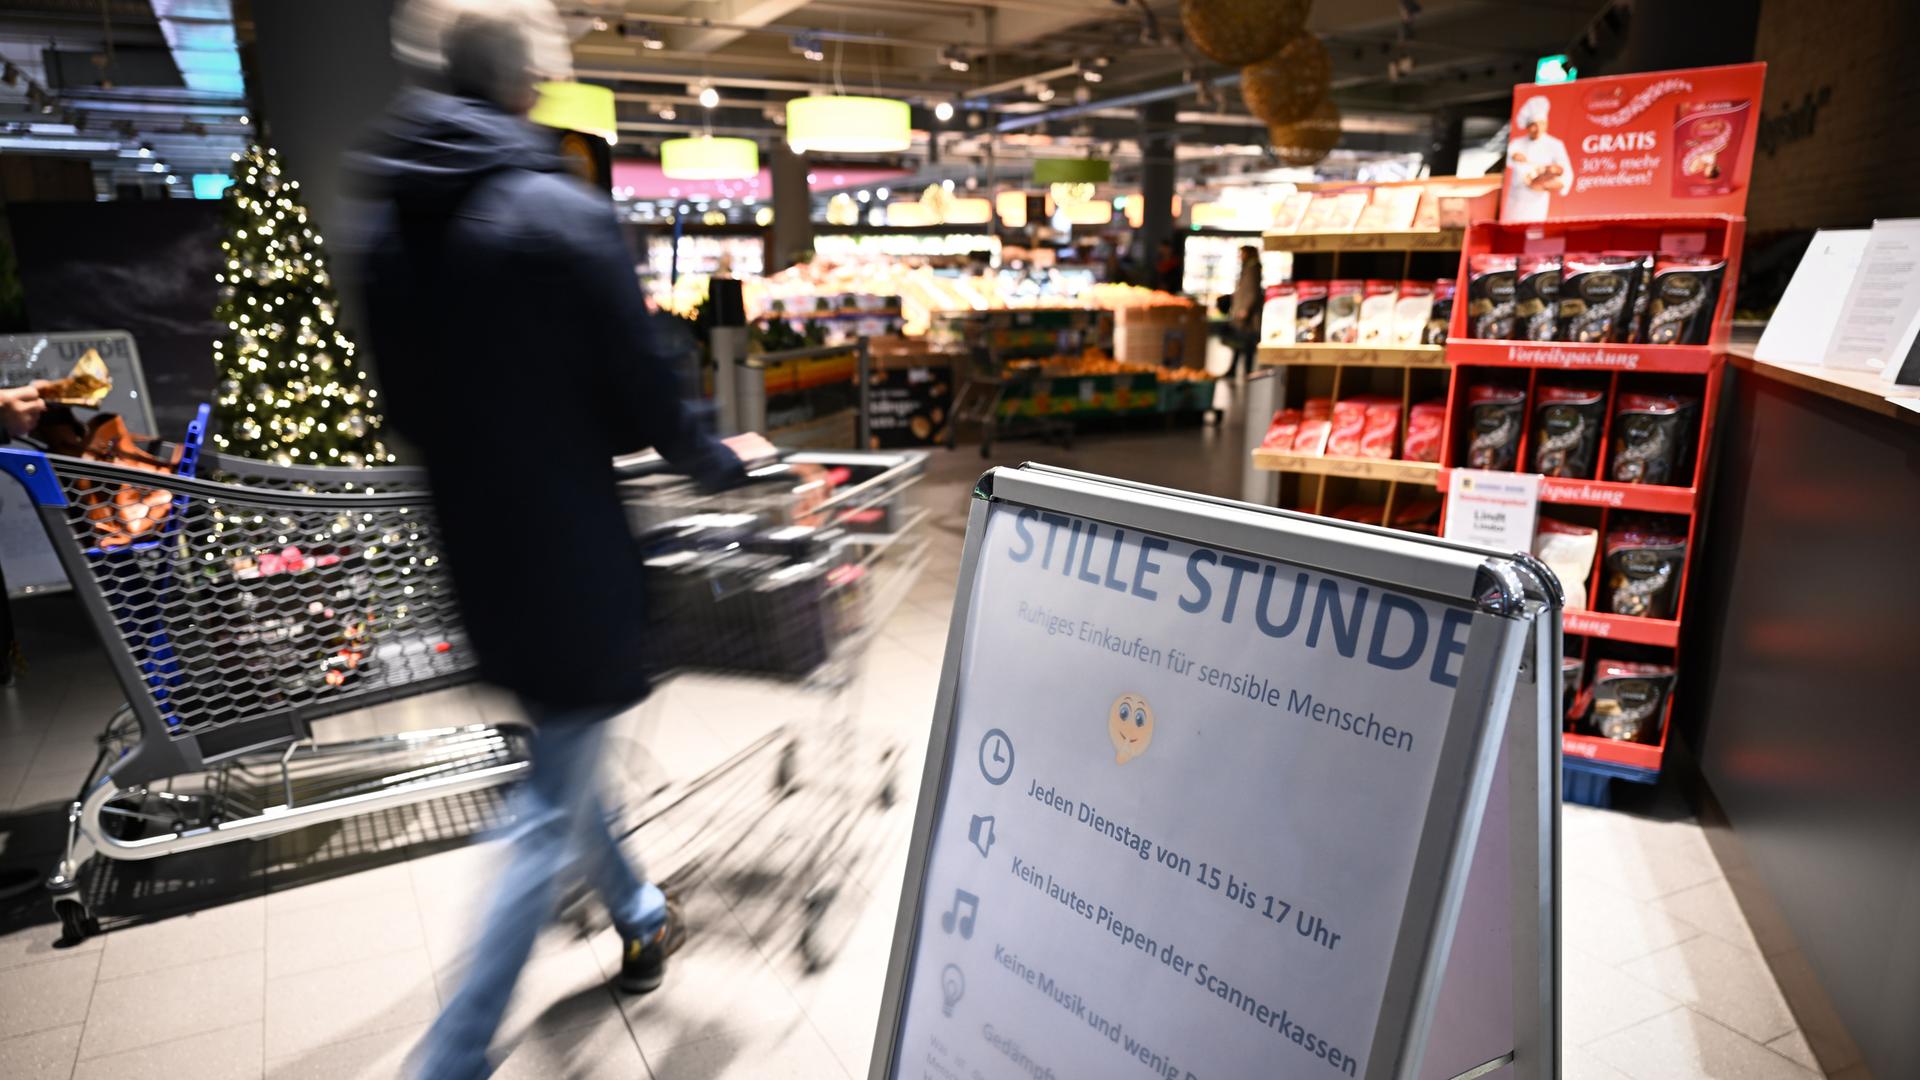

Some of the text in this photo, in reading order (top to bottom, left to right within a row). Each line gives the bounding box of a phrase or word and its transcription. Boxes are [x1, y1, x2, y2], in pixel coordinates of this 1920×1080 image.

[1582, 131, 1656, 153] GRATIS
[1620, 154, 1661, 170] mehr
[1508, 346, 1639, 369] Vorteilspackung
[1008, 508, 1474, 689] STILLE STUNDE
[1017, 600, 1415, 752] Ruhiges Einkaufen für sensible Menschen
[1027, 778, 1341, 951] Jeden Dienstag von 15 bis 17 Uhr
[994, 944, 1180, 1080] Keine Musik und wenig
[1011, 855, 1358, 1078] Kein lautes Piepen der Scannerkassen
